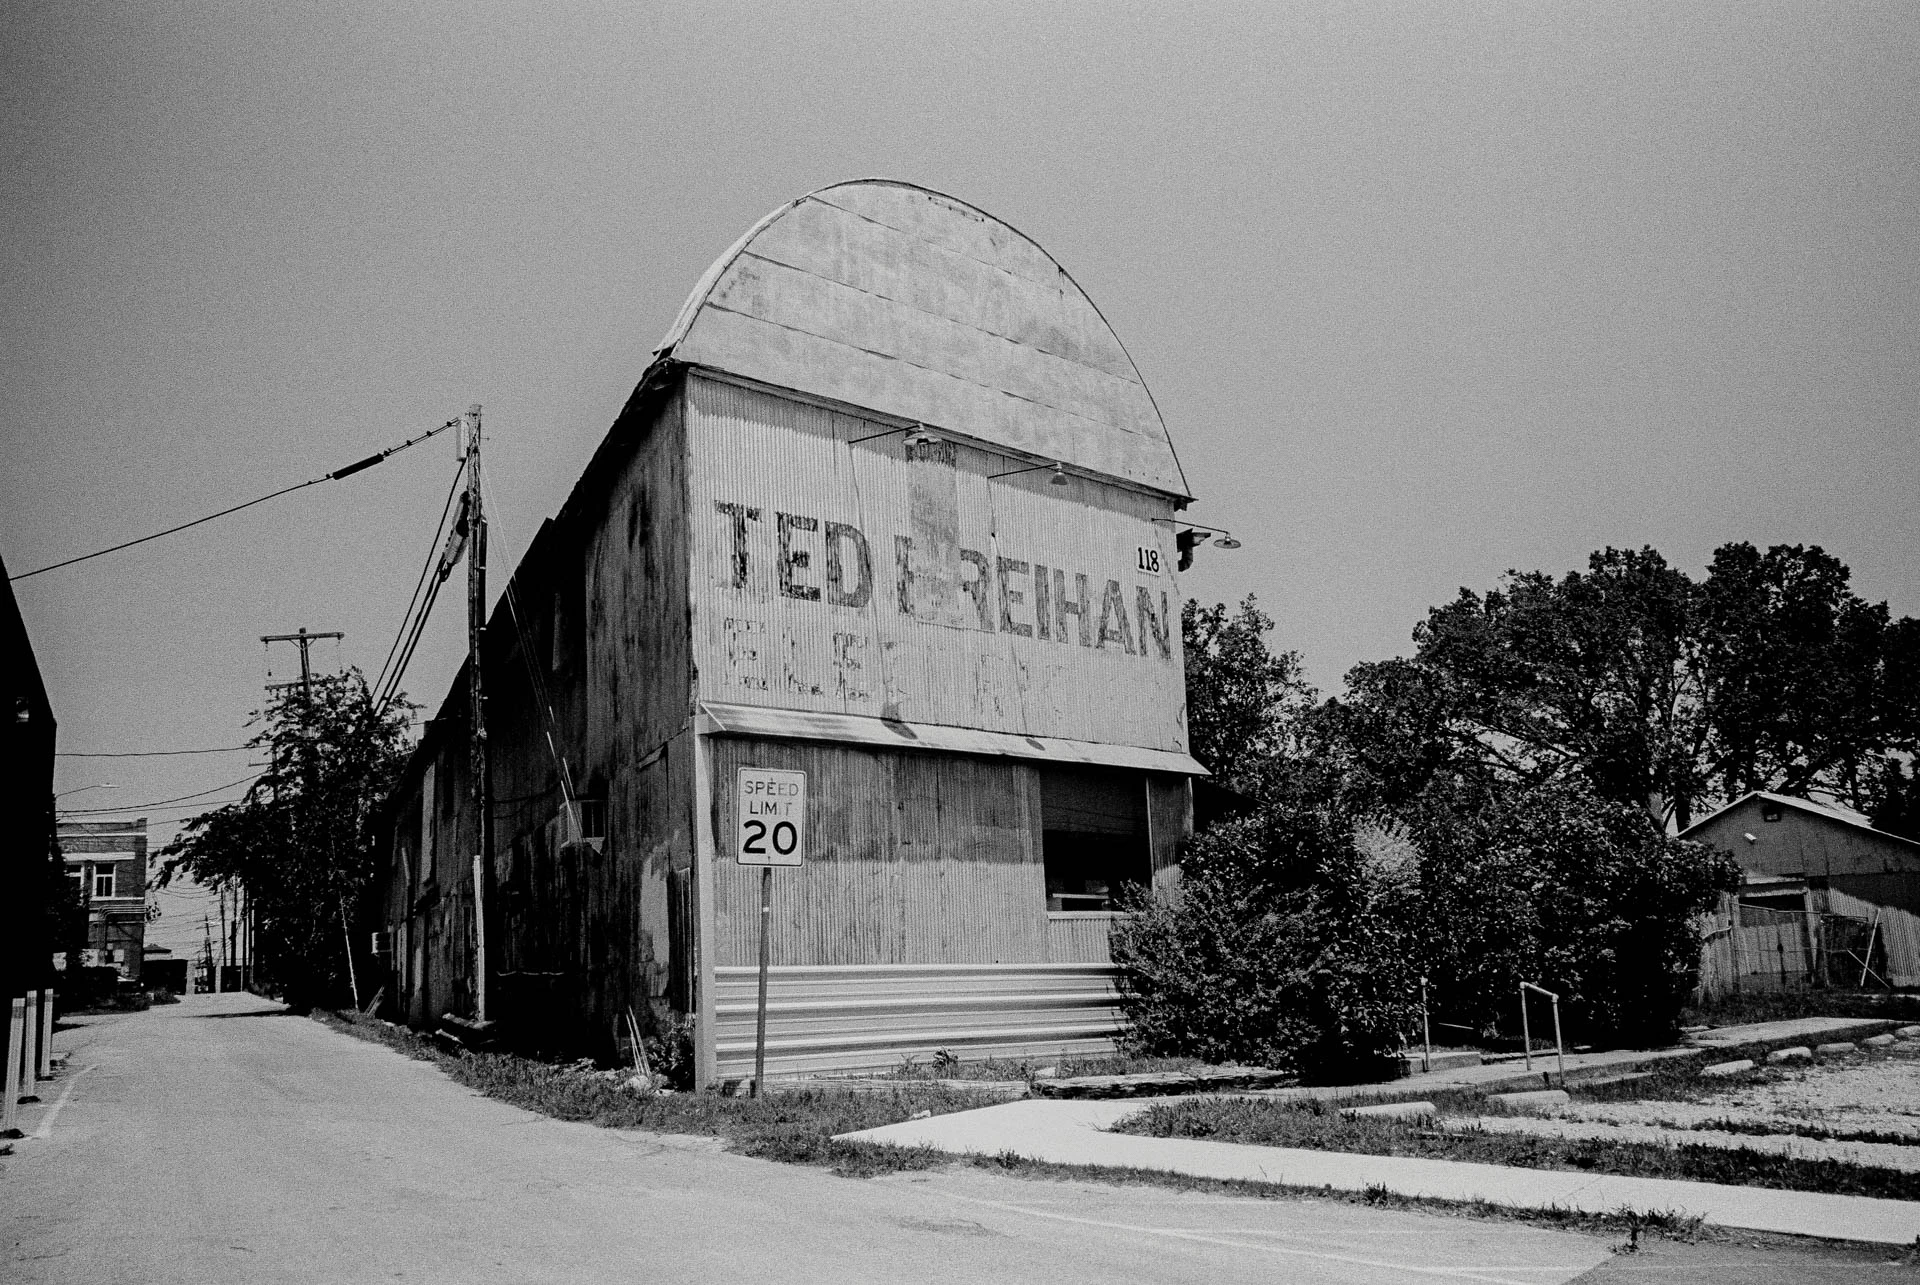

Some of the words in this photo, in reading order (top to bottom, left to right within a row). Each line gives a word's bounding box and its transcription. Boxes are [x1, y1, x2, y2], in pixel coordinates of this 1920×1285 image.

[714, 500, 873, 609] TED
[1138, 547, 1159, 572] 118
[744, 780, 799, 796] SPEED
[749, 800, 792, 816] LIMT
[743, 819, 798, 855] 20
